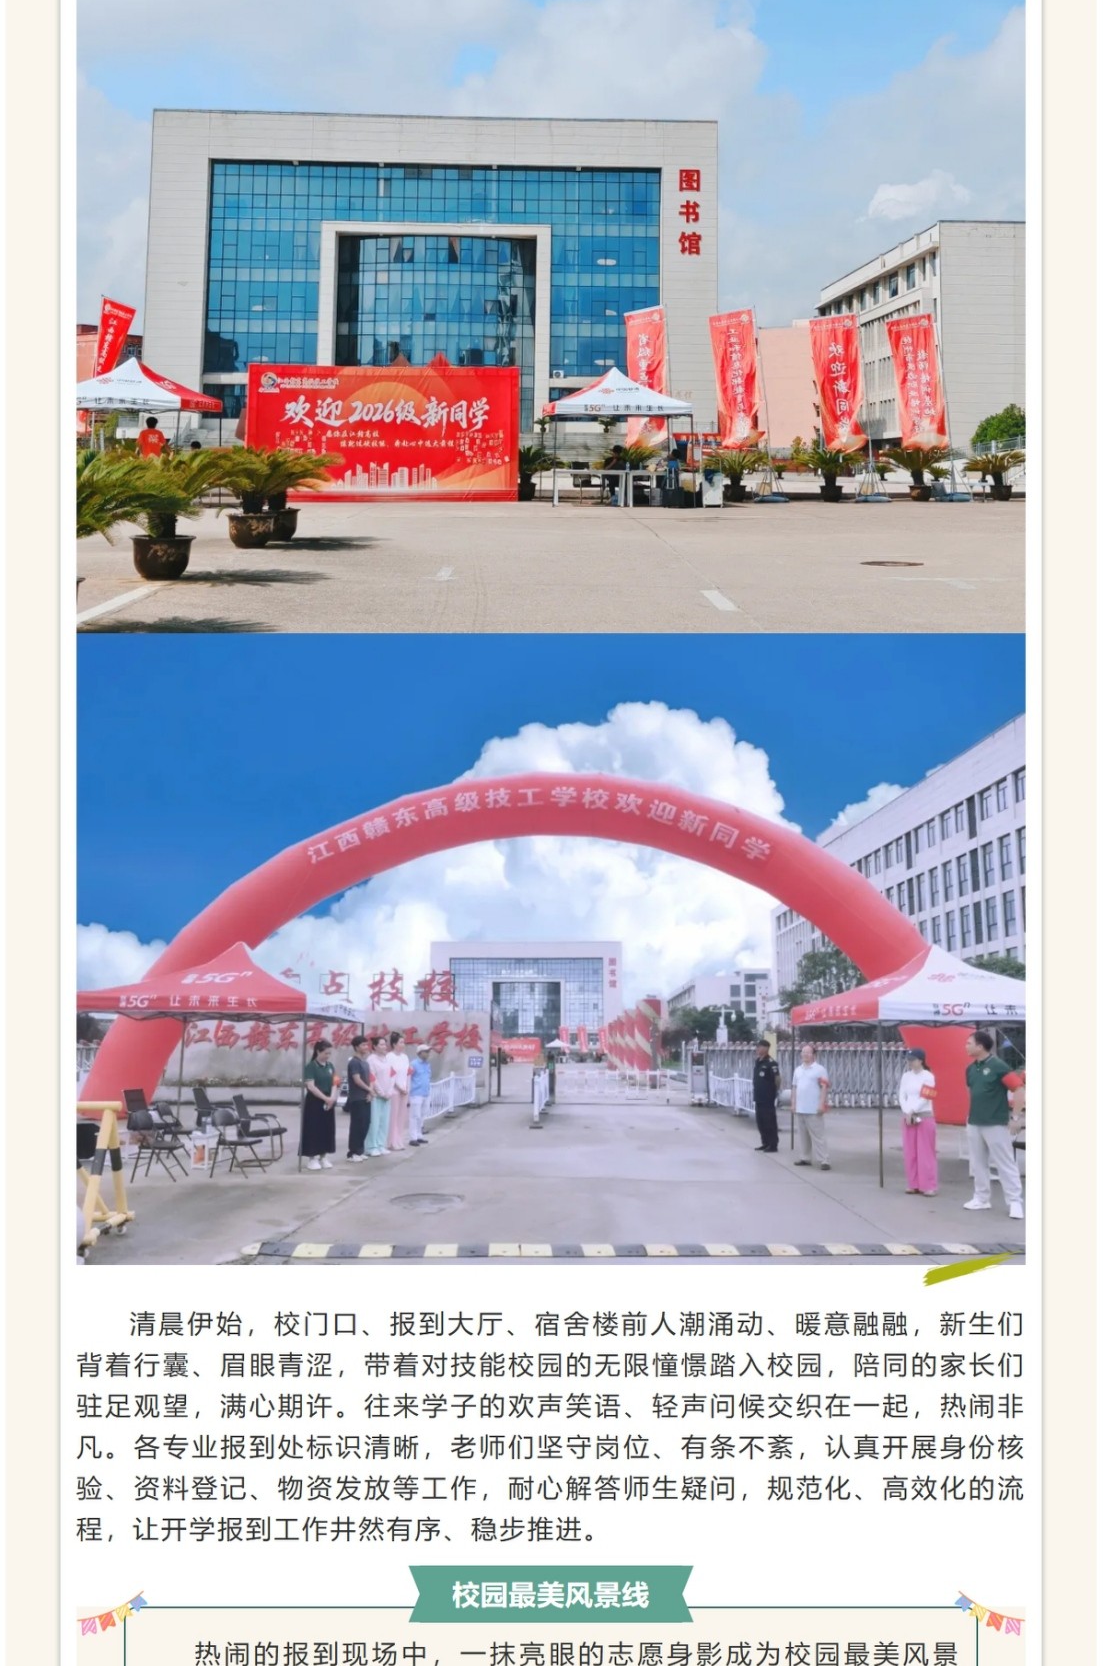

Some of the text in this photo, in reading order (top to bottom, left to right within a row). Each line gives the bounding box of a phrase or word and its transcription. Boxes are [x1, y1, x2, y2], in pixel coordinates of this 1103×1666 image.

[679, 167, 702, 257] 图书馆
[306, 785, 773, 864] 江西赣东高级技工学校欢迎新同学
[169, 995, 258, 1007] 让未来生长
